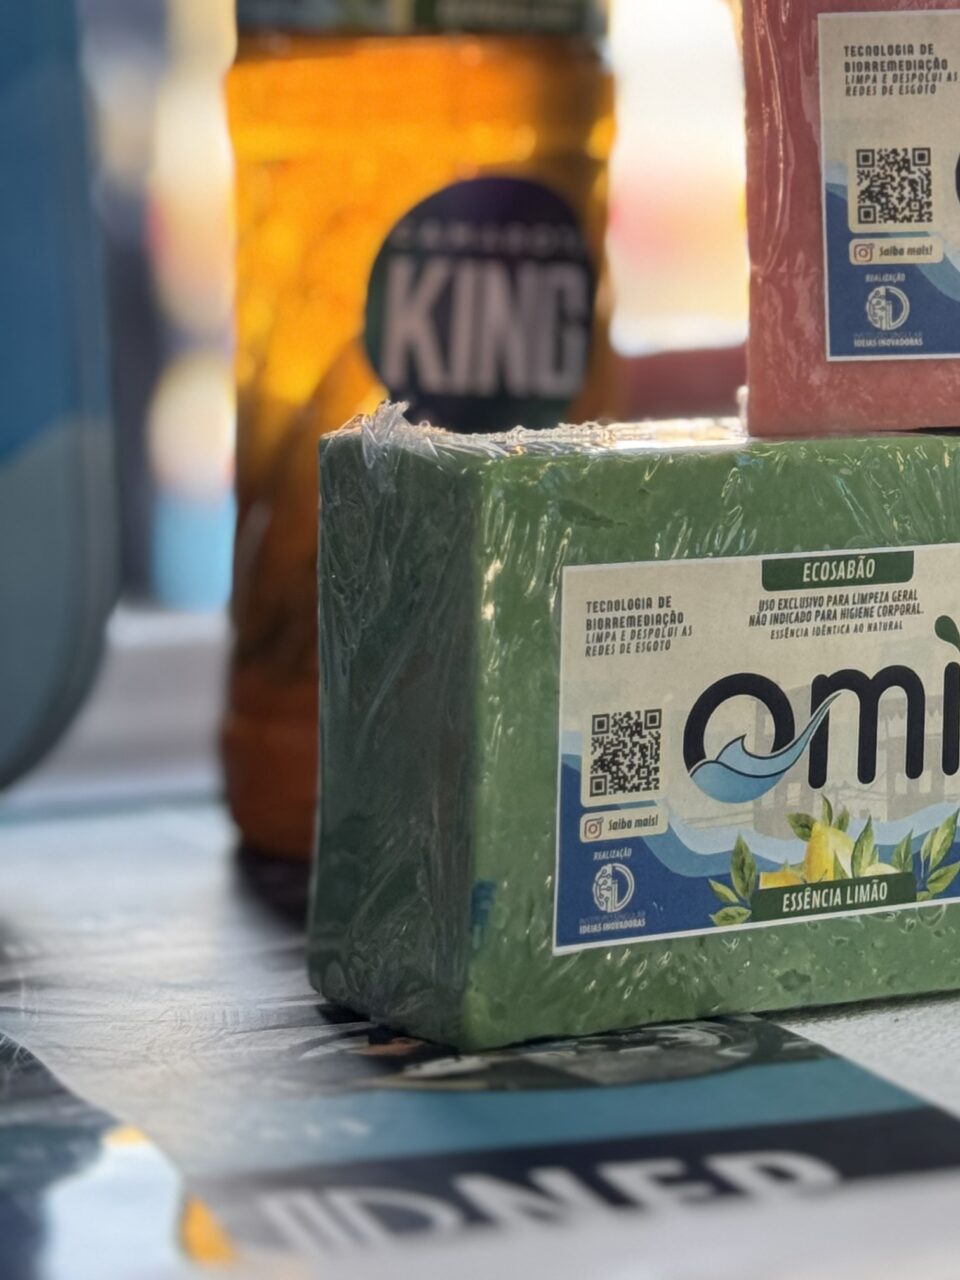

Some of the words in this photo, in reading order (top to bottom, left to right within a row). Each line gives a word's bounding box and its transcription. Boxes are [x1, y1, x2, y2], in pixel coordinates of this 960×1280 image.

[843, 43, 915, 58] TECNOLOGIA
[919, 43, 935, 56] DE
[843, 56, 949, 74] BIORREMEDIAÇÃO
[845, 73, 878, 85] LIMPA
[882, 73, 887, 84] E
[946, 71, 958, 82] AS
[845, 84, 878, 97] REDES
[882, 84, 894, 96] DE
[899, 83, 937, 95] ESGOTO
[802, 556, 876, 582] ECOSABÃO
[586, 596, 653, 613] TECNOLOGIA
[658, 595, 672, 609] DE
[758, 599, 776, 613] USO
[777, 595, 824, 612] EXCLUSIVO
[826, 594, 849, 607] PARA
[852, 591, 889, 605] LIMPEZA
[891, 589, 918, 602] GERAL
[586, 610, 684, 631] BIORREMEDIAÇÃO
[748, 611, 767, 627] NÃO
[769, 610, 812, 626] INDICADO
[814, 609, 837, 623] PARA
[840, 606, 874, 620] HIGIENE
[877, 603, 925, 618] CORPORAL.
[586, 631, 617, 645] LIMPA
[620, 630, 626, 642] E
[630, 626, 678, 641] DESPOLUI
[681, 625, 693, 637] AS
[770, 627, 809, 640] ESSÊNCIA
[812, 624, 850, 637] IDÊNTICA
[853, 623, 864, 633] AO
[867, 621, 903, 632] NATURAL
[585, 643, 615, 658] REDES
[619, 642, 631, 655] DE
[635, 639, 672, 653] ESGOTO
[608, 819, 632, 831] Saiba
[634, 814, 659, 828] mais!
[782, 887, 842, 913] ESSÊNCIA
[846, 879, 888, 905] LIMÃO
